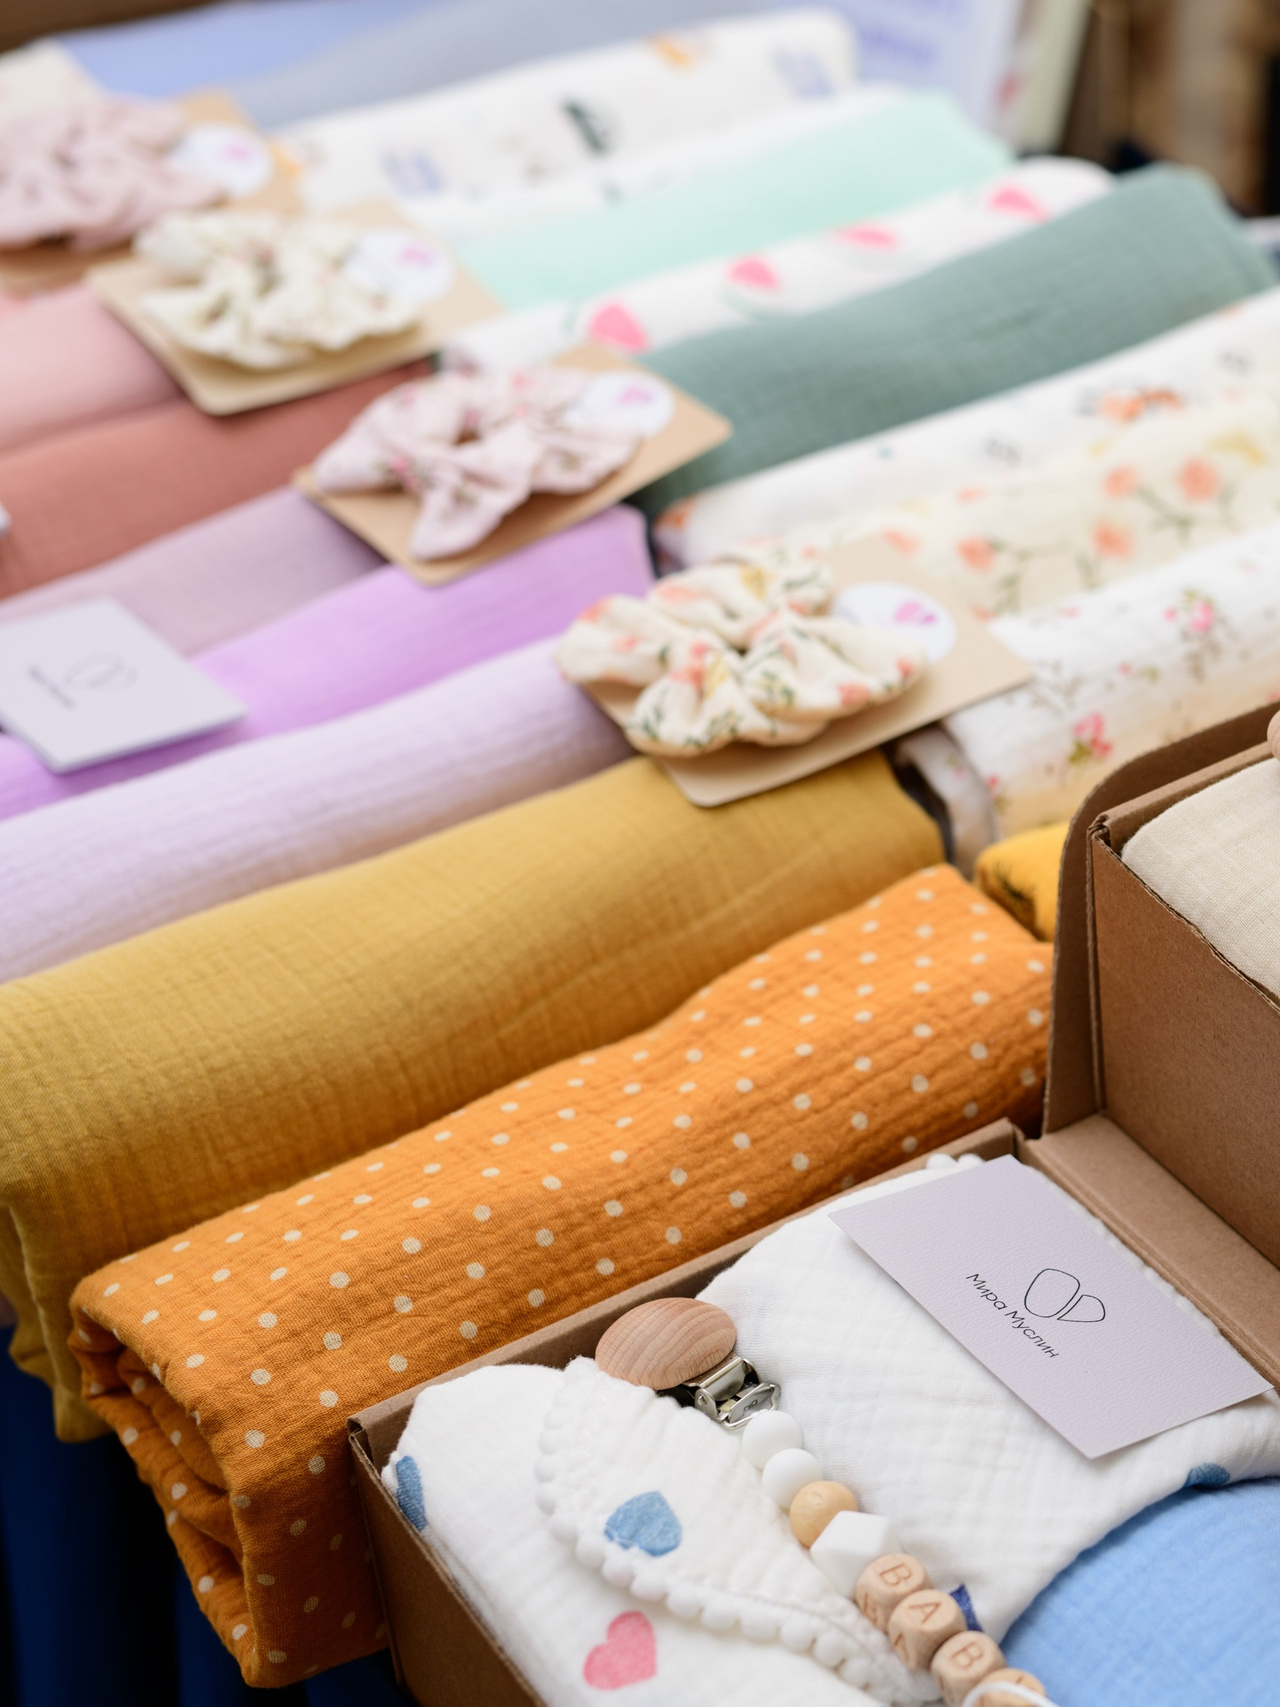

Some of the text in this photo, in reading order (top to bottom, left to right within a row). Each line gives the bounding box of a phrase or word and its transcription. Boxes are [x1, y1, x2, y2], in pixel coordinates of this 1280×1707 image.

[965, 1273, 1060, 1358] Мира Муслин
[878, 1562, 1024, 1685] BAB
